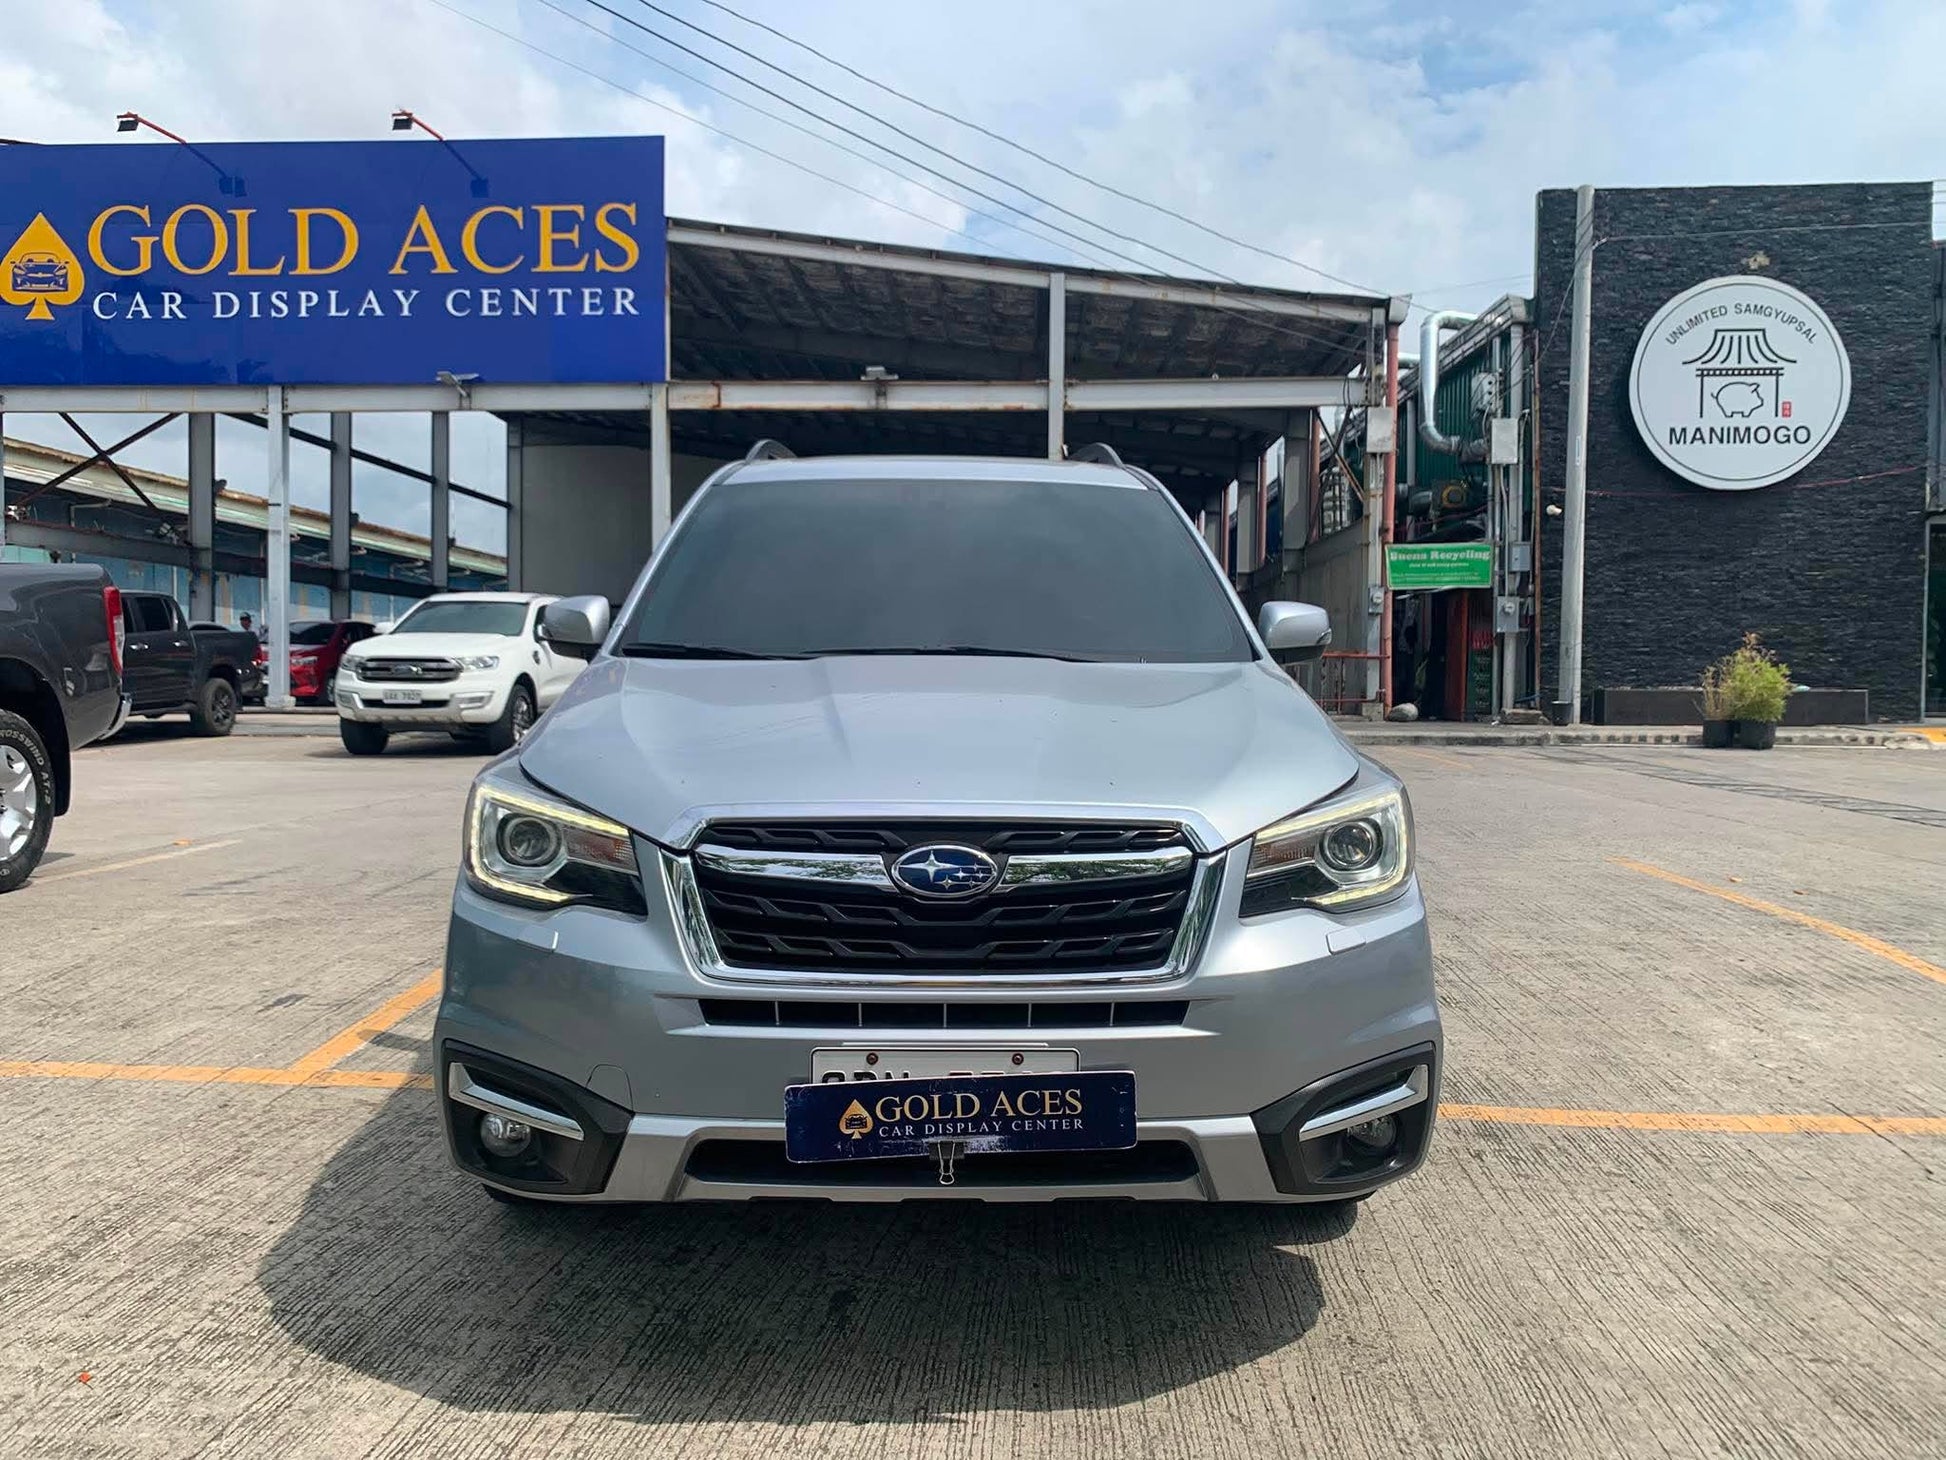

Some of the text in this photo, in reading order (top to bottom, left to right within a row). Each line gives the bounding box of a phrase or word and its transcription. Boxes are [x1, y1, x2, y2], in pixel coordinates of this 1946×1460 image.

[87, 202, 640, 277] GOLD ACES
[93, 287, 639, 320] CAR DISPLAY CENTER
[1665, 302, 1818, 346] UNLIMITED SAMGYUPSAL
[1668, 425, 1812, 446] MANIMOGO
[1430, 549, 1490, 561] Recycling
[874, 1089, 1084, 1122] GOLD ACES
[879, 1118, 1084, 1138] CAR DISPLAY CENTER
